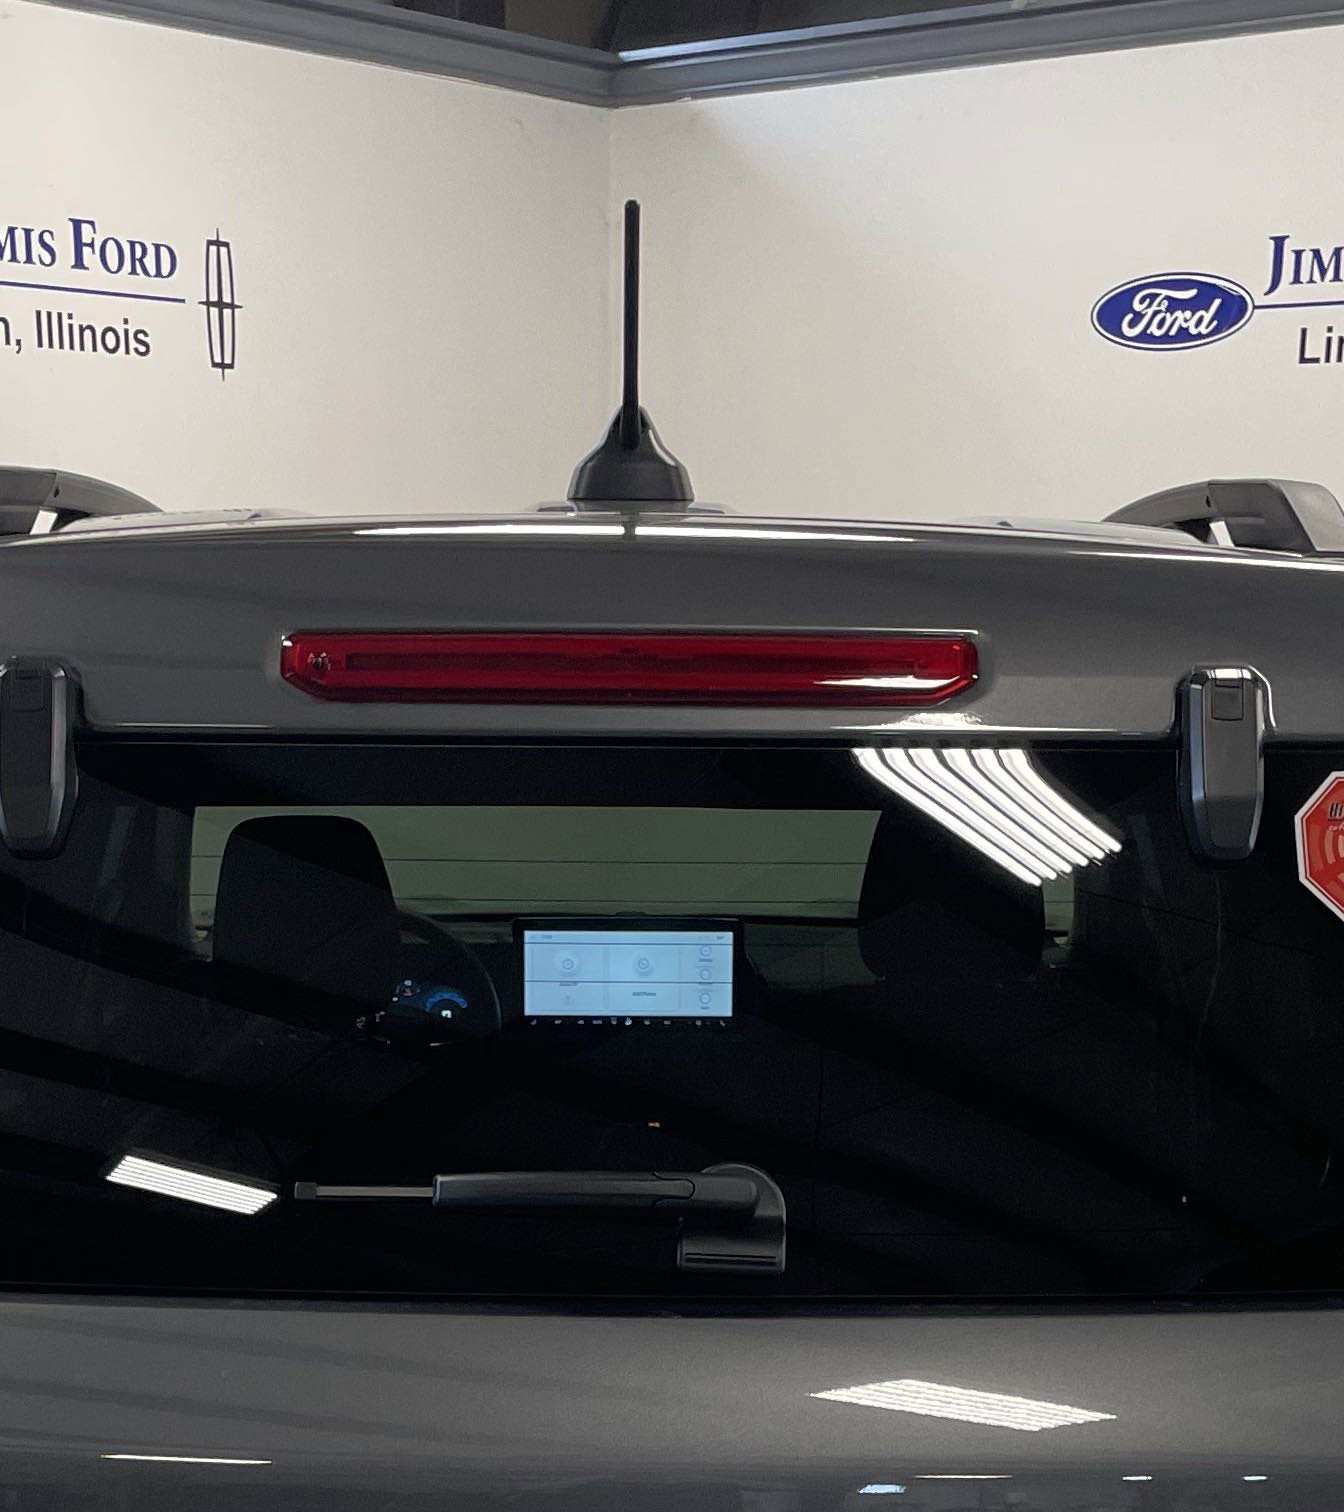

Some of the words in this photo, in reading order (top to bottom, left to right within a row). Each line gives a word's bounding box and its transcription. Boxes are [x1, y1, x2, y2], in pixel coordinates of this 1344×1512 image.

[68, 216, 178, 279] FORD
[1264, 234, 1344, 296] JIM
[35, 310, 152, 357] Illinois
[1121, 288, 1218, 338] Ford
